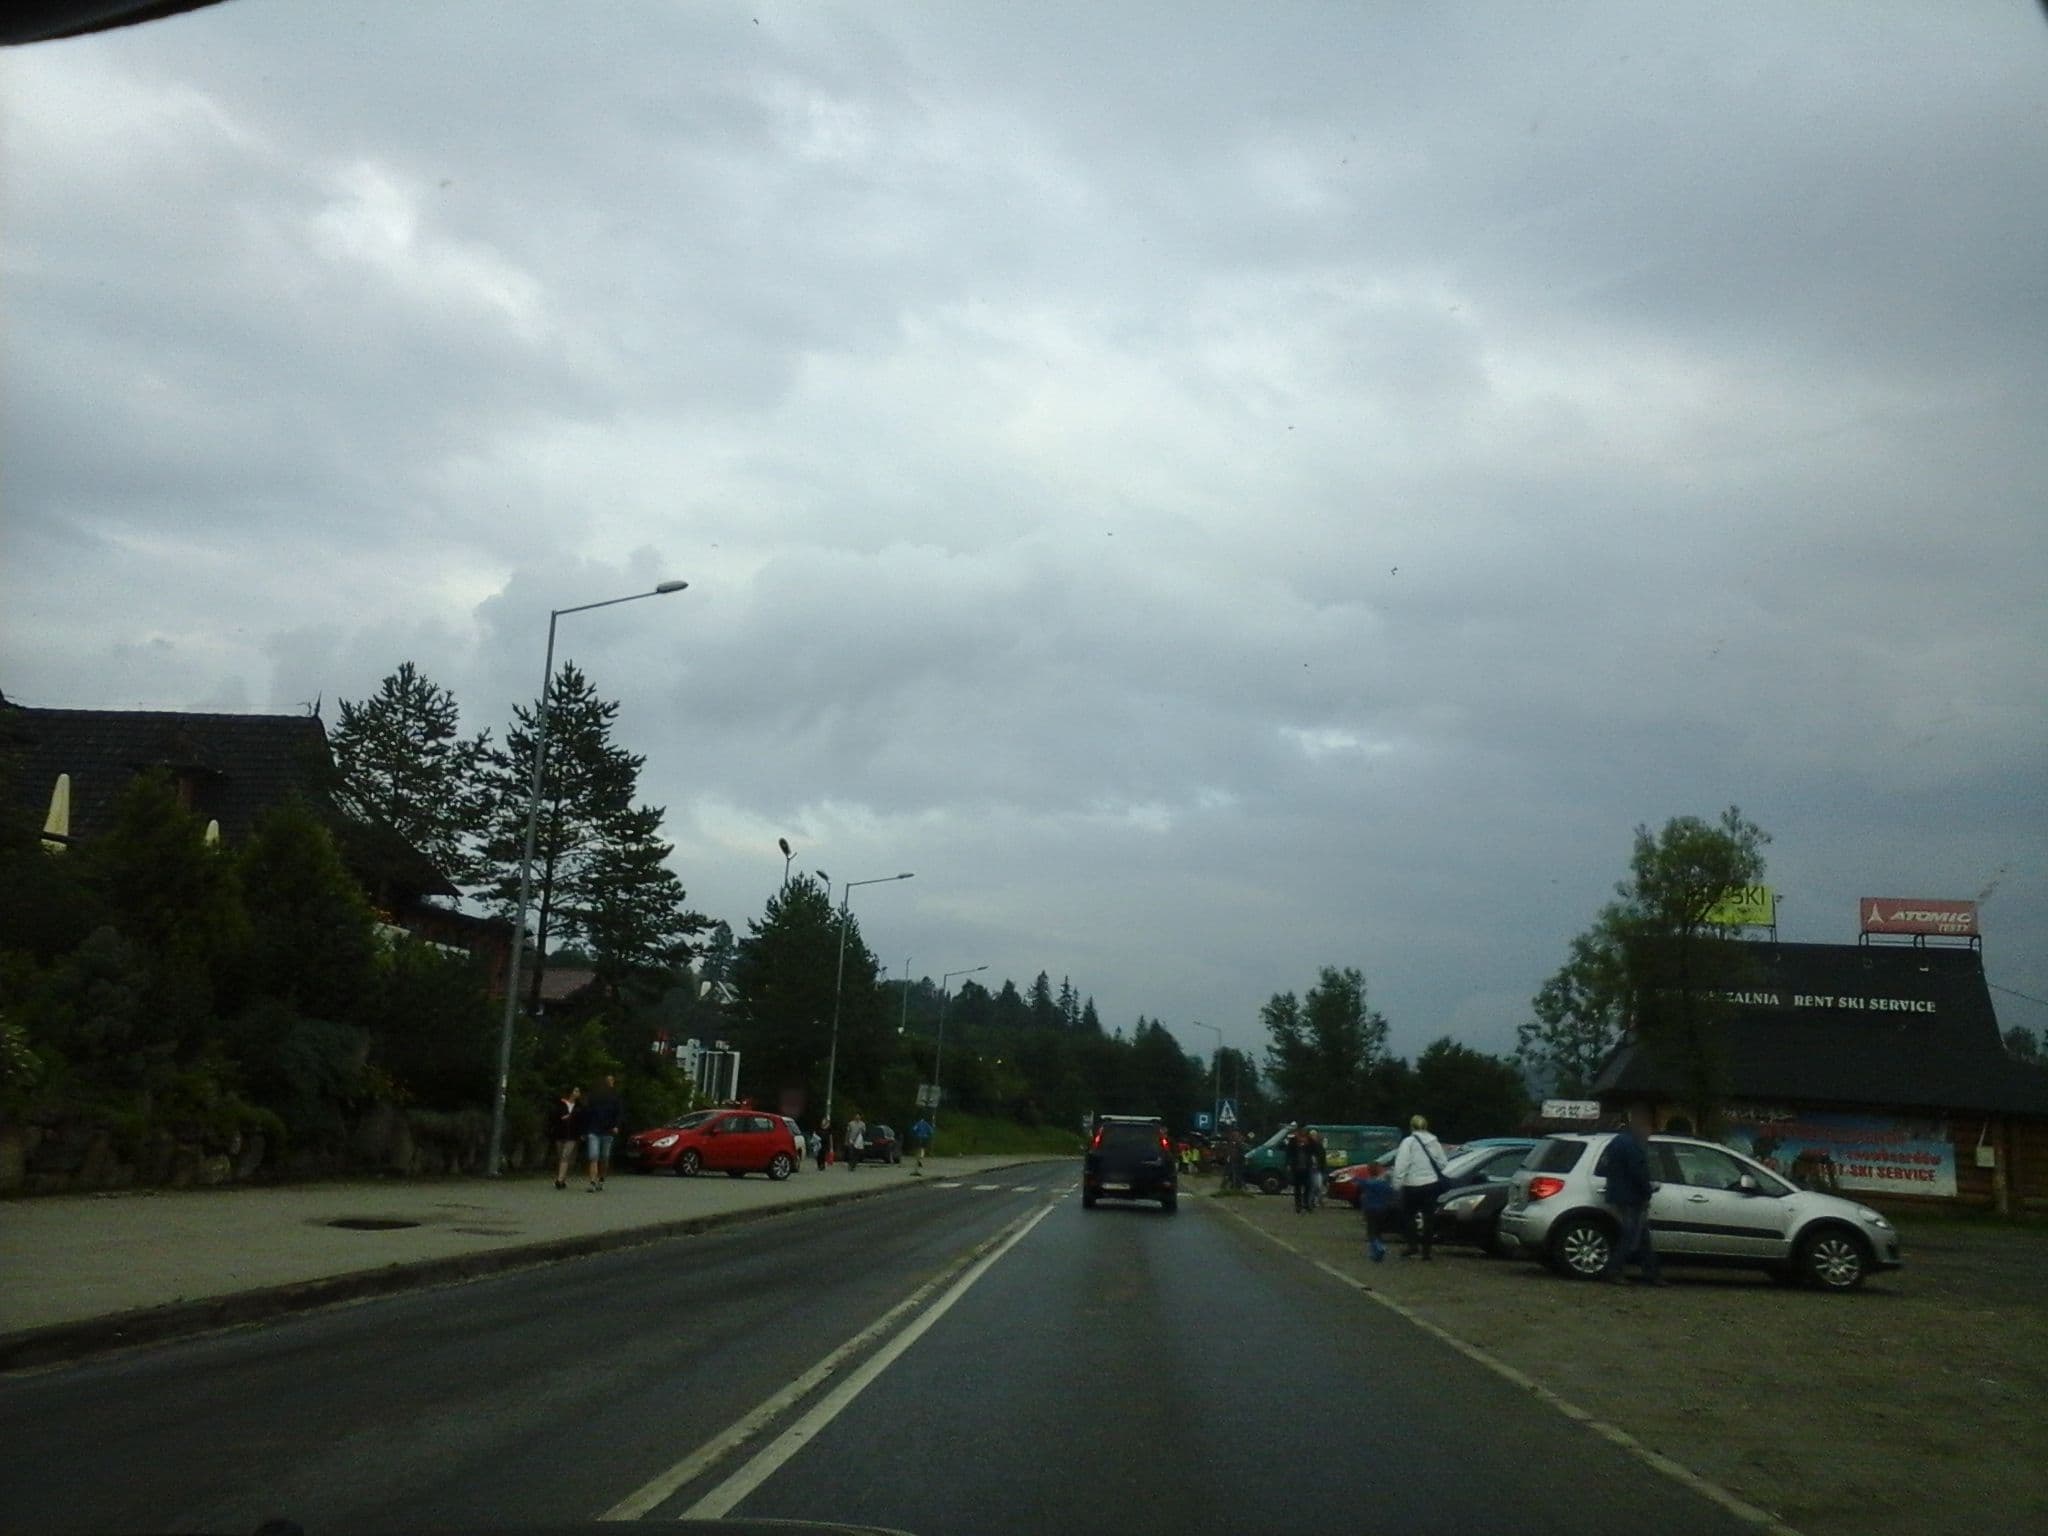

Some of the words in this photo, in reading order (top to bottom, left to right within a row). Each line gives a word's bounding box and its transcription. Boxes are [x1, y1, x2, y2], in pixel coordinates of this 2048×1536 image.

[1731, 886, 1765, 905] SKI
[1890, 910, 1972, 922] ATOMIC
[1726, 991, 1780, 1005] ZALNIA
[1794, 994, 1833, 1007] RENT
[1838, 996, 1865, 1009] SKI
[1869, 997, 1937, 1013] SERVICE
[1199, 1113, 1209, 1128] P
[1847, 1165, 1873, 1178] SKI
[1876, 1166, 1936, 1181] SERVICE
